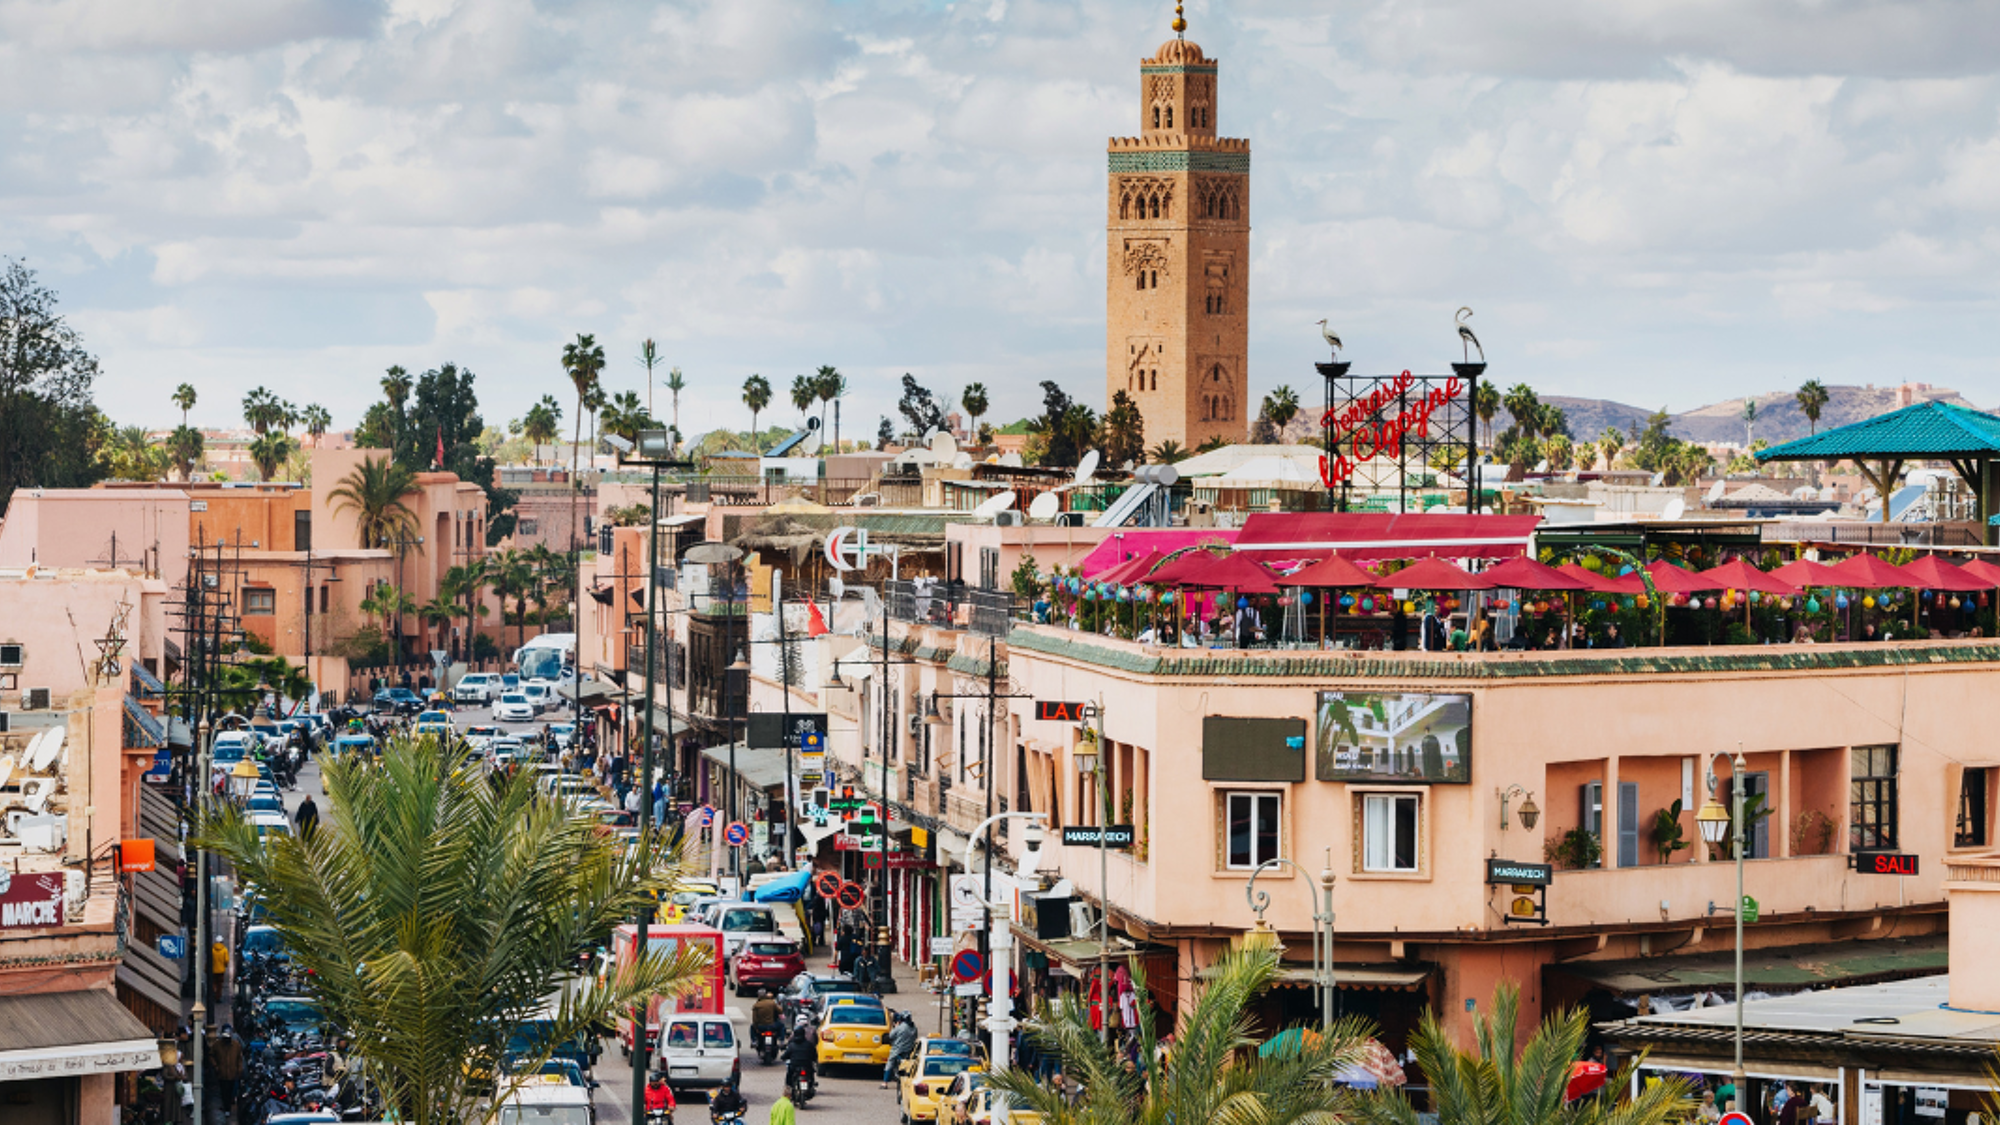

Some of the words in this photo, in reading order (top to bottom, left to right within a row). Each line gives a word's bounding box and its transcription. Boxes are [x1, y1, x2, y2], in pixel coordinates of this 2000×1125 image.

[1321, 369, 1415, 442] Terrasse
[1354, 377, 1462, 461] Cigogne
[1042, 702, 1070, 720] LA
[1494, 867, 1545, 878] MARRAKECH
